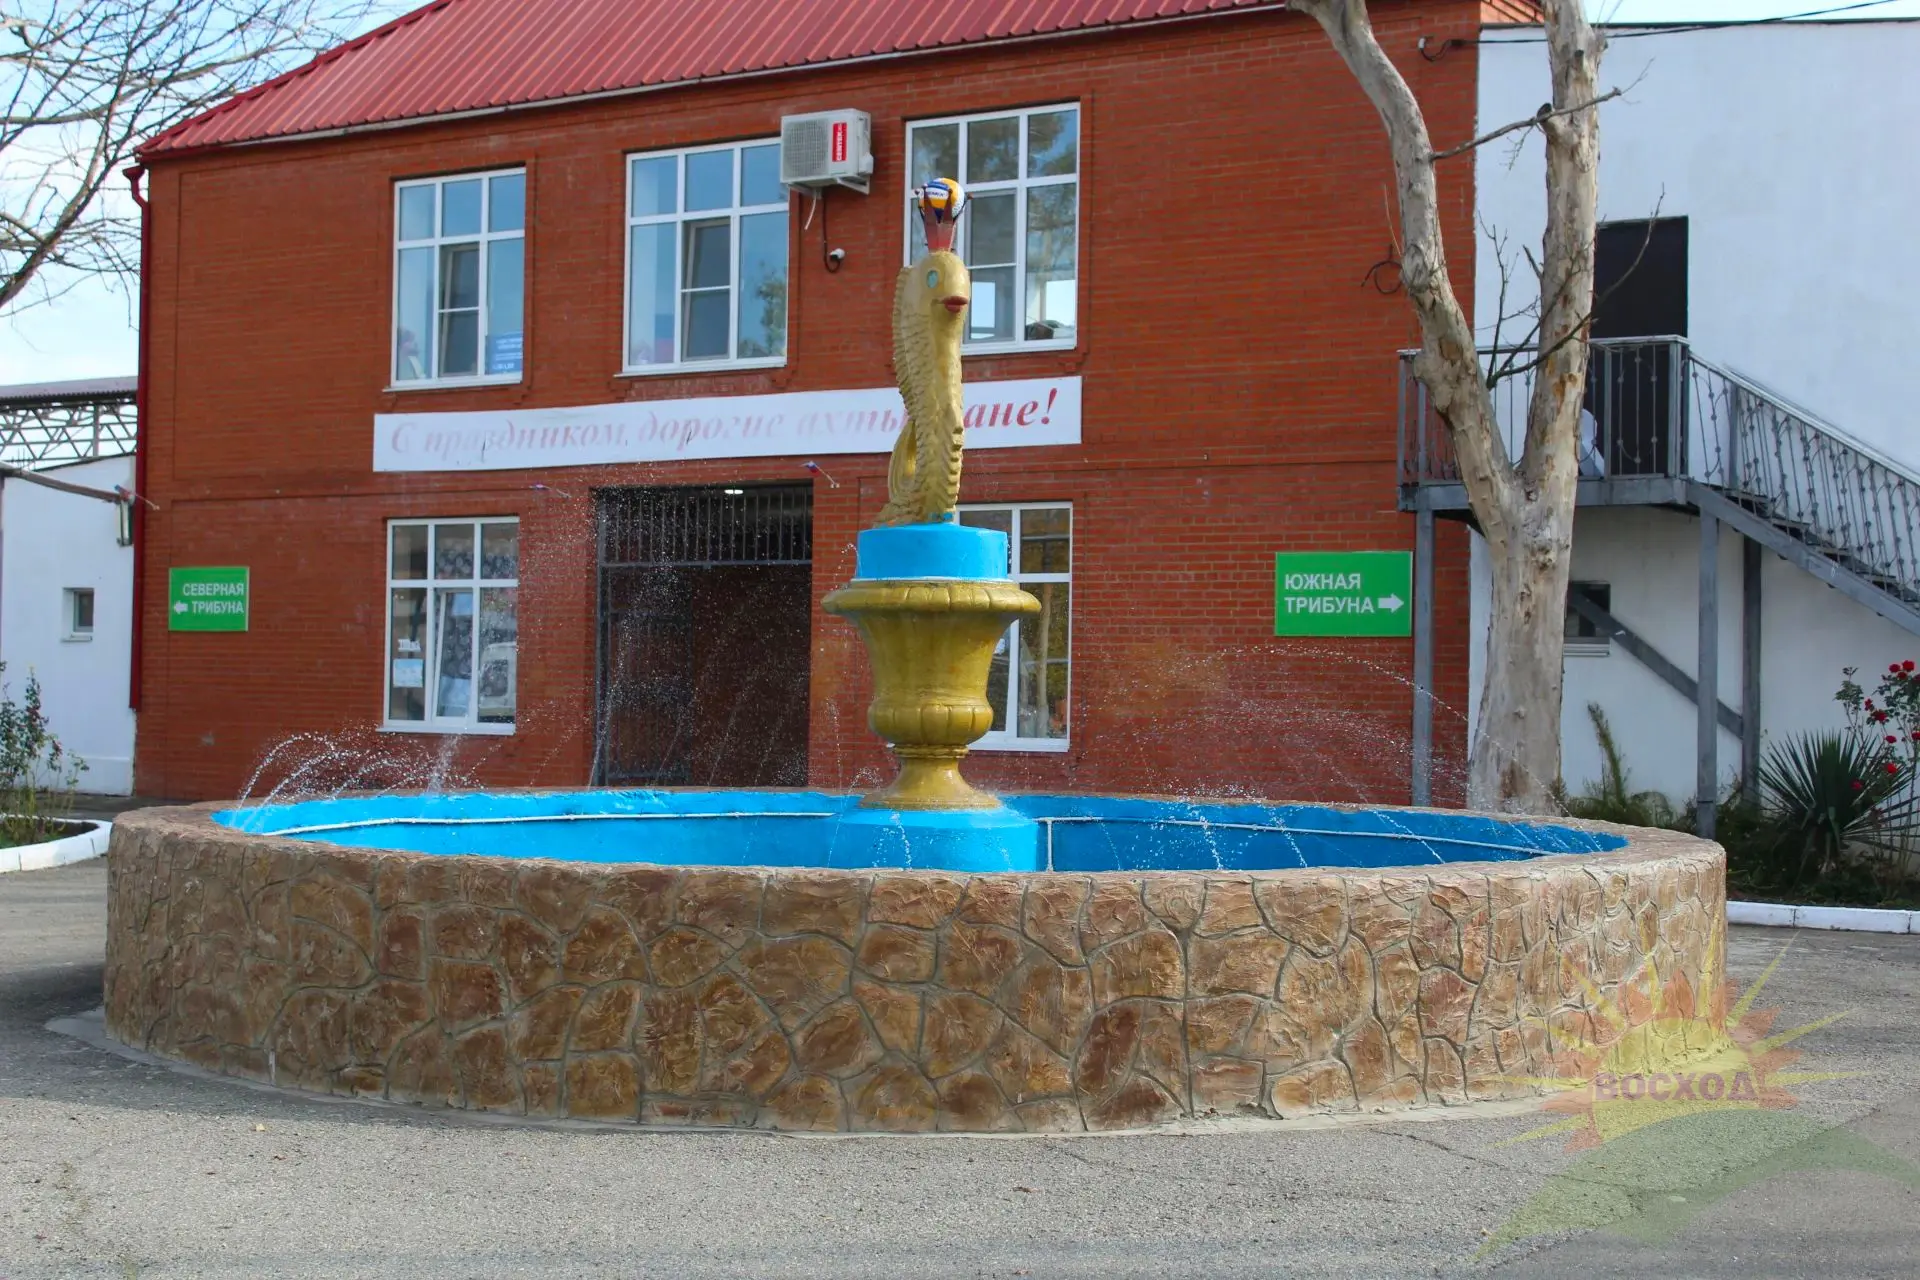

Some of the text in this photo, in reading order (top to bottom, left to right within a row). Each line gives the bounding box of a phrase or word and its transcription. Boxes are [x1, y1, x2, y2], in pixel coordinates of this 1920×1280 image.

[392, 421, 418, 453] С
[182, 583, 244, 596] СЕВЕРНАЯ
[1284, 573, 1361, 590] ЮЖНАЯ
[191, 601, 244, 614] ТРИБУНА
[1284, 597, 1375, 614] ТРИБУНА
